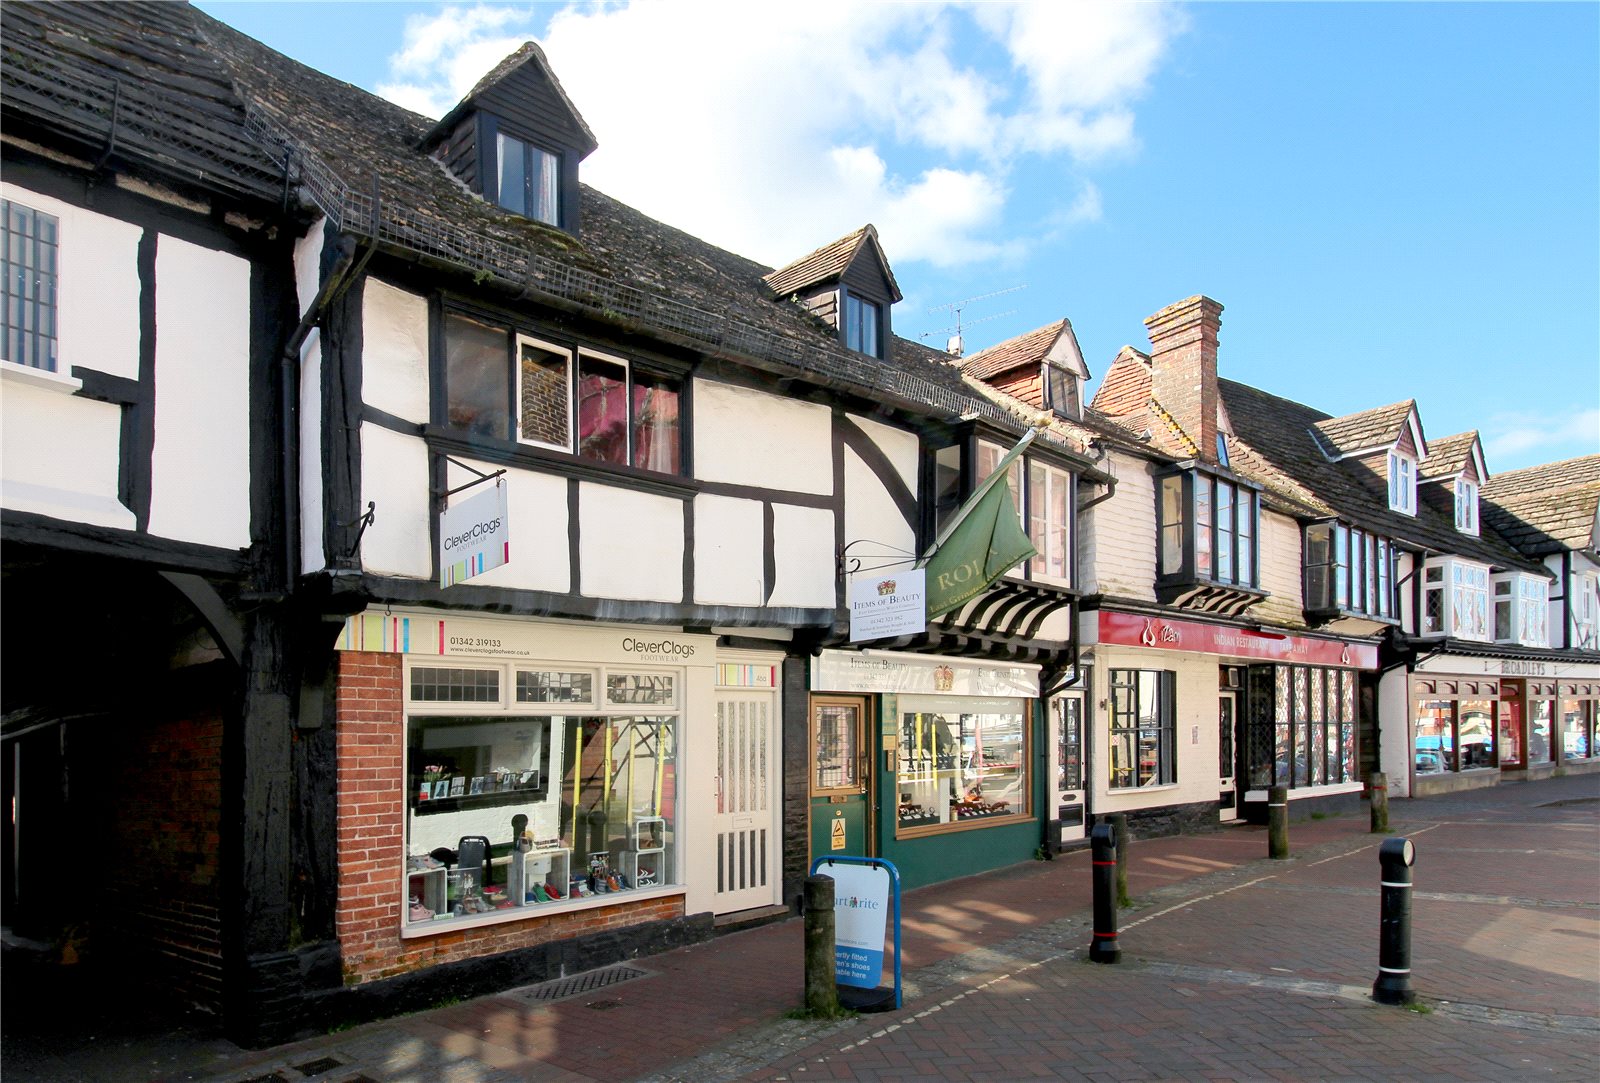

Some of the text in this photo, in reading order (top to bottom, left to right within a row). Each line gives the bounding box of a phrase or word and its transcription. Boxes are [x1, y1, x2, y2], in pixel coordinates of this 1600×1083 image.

[444, 517, 501, 551] CleverClogs
[456, 535, 487, 553] FOOTWEAR
[854, 600, 876, 610] ITEMS
[877, 598, 887, 606] OF
[889, 593, 921, 604] BEAUTY
[450, 636, 502, 648] 01342 319133
[622, 637, 695, 659] CleverClogs
[1213, 633, 1236, 648] INDIAN
[1236, 635, 1268, 651] RESTAURANT
[640, 654, 680, 663] FOOTWEAR
[851, 657, 871, 668] ITEMS
[882, 659, 908, 671] BEAUTY
[1501, 660, 1546, 675] BROADLEYS
[859, 897, 879, 910] rite
[851, 953, 868, 962] fitted
[851, 962, 871, 971] shoes
[851, 970, 867, 979] here
